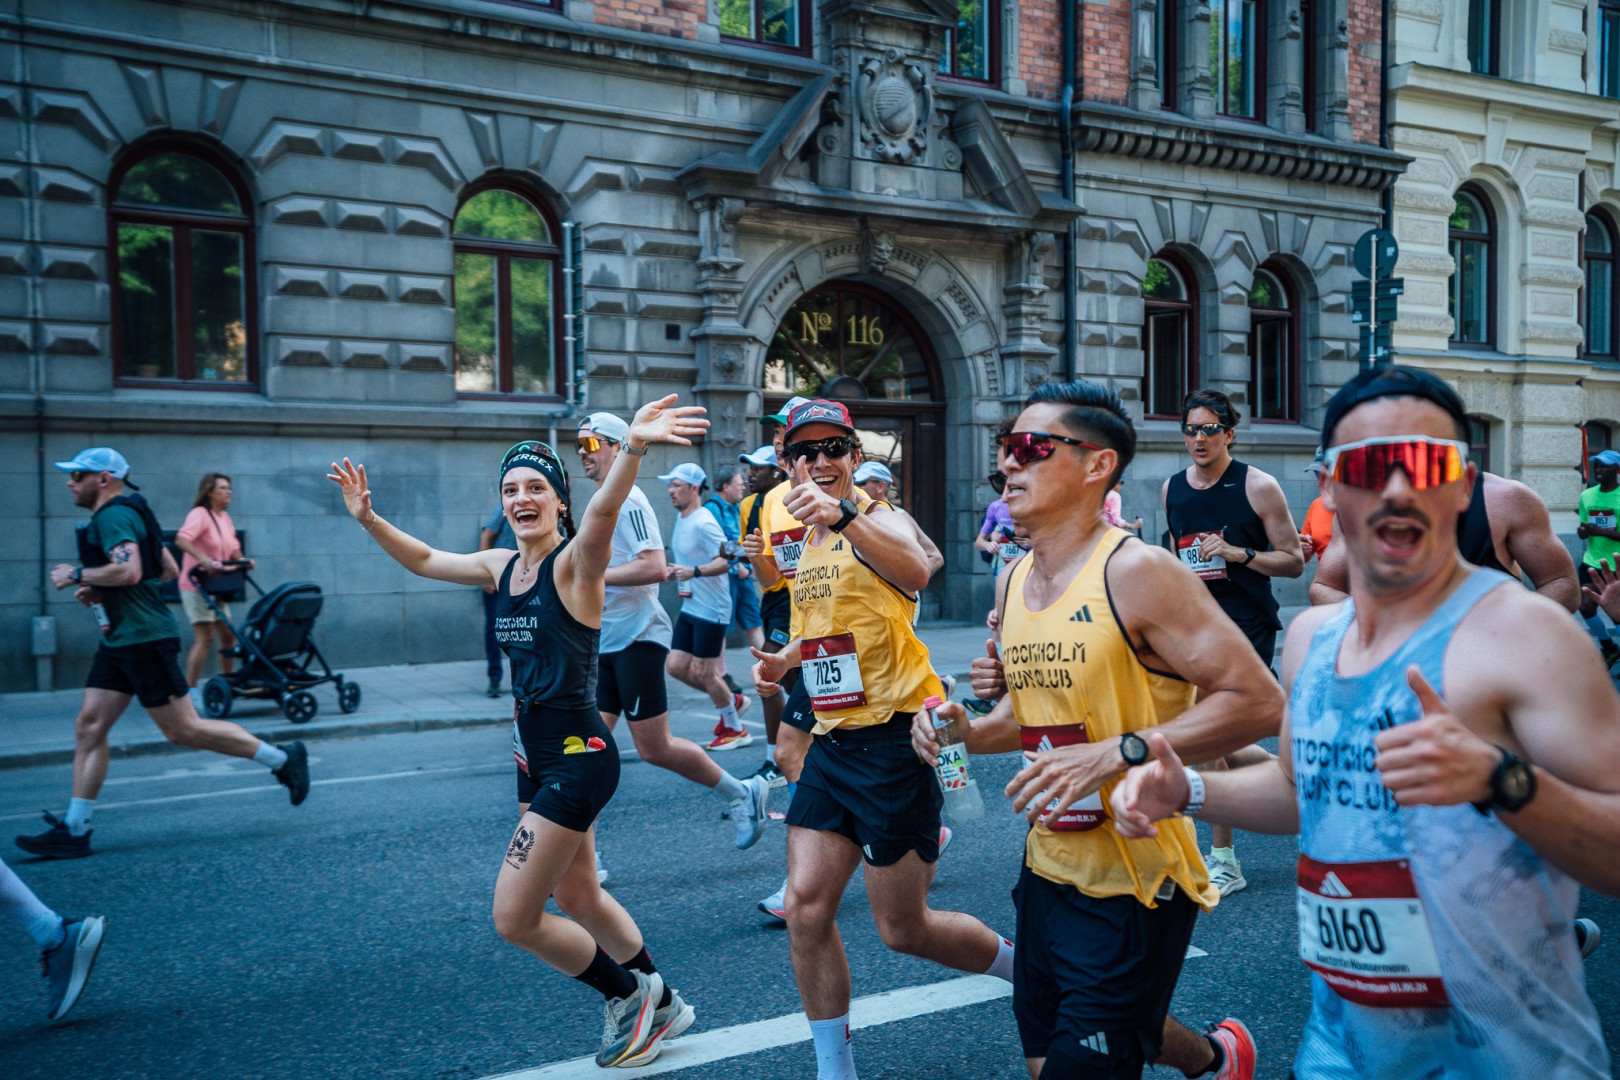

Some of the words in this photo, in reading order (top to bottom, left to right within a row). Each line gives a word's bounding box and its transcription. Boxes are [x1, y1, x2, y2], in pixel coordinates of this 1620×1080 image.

[848, 315, 884, 345] 116
[507, 453, 554, 473] TERREX
[794, 564, 839, 587] TOCKHOLM
[495, 616, 538, 629] TOCKHOLM
[813, 659, 842, 686] 7125
[936, 750, 961, 767] OKA
[1317, 904, 1387, 955] 6160
